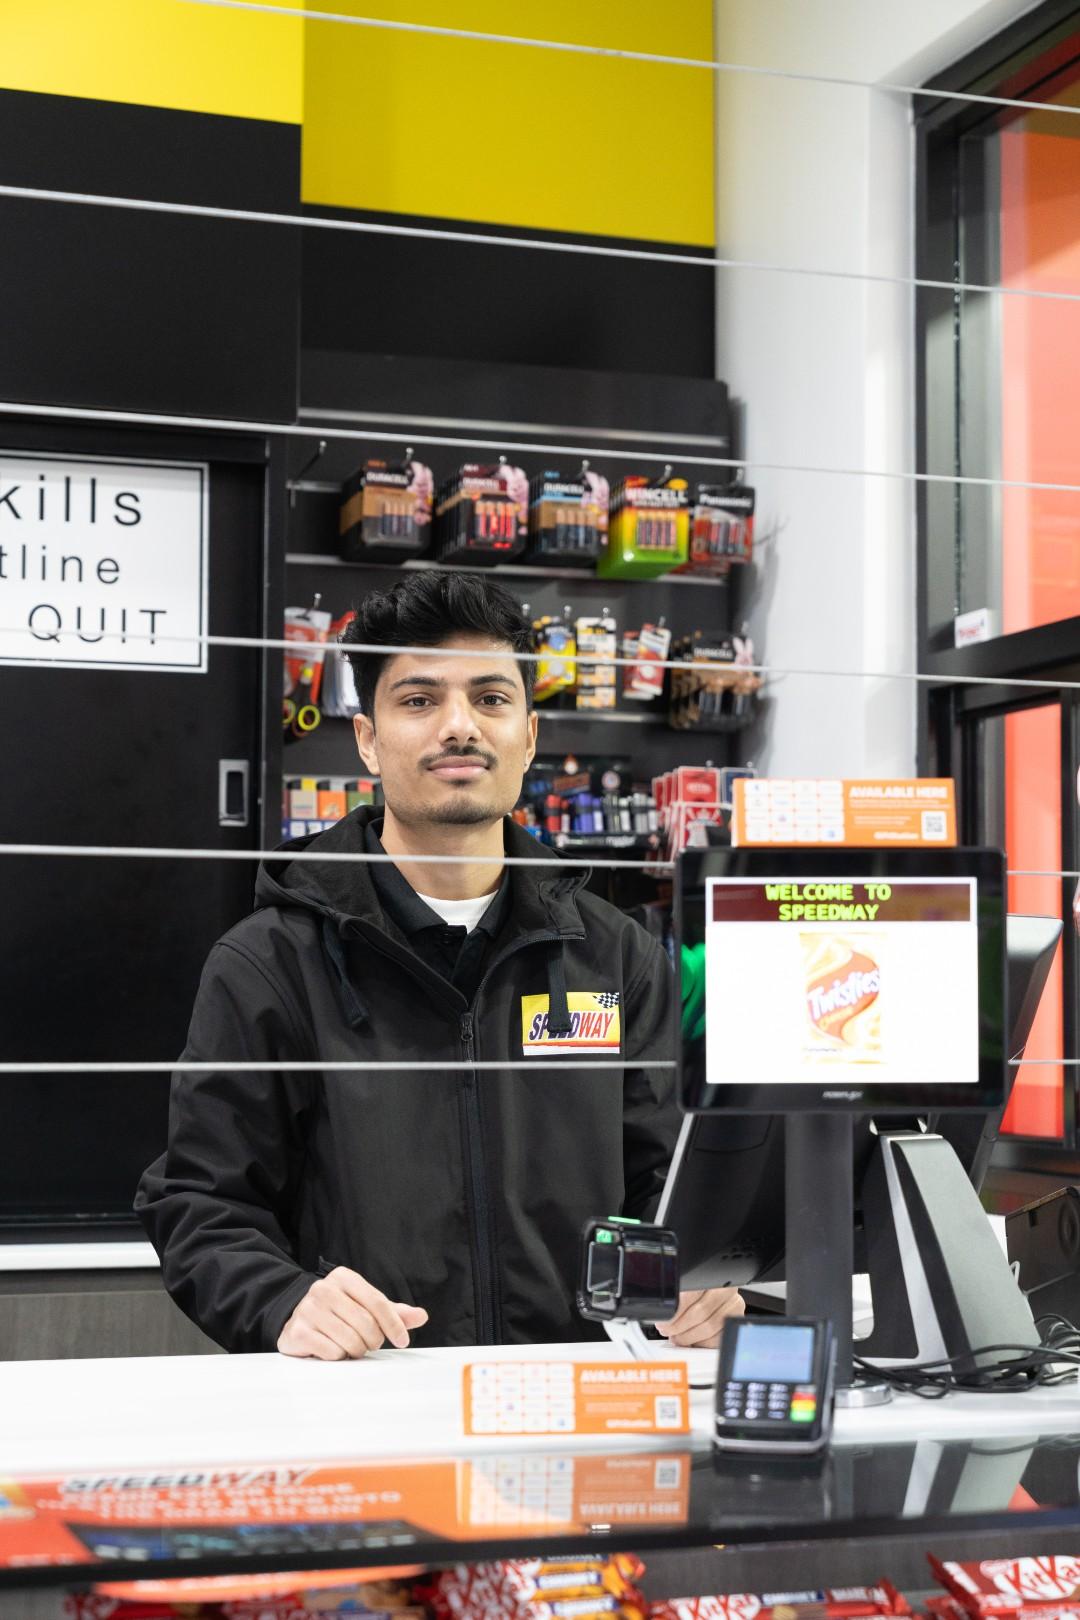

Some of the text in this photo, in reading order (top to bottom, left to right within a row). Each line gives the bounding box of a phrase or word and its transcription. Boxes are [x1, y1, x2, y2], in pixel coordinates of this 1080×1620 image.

[27, 603, 168, 645] QUIT
[765, 884, 892, 901] WELCOME TO
[778, 904, 880, 921] SPEEDWAY
